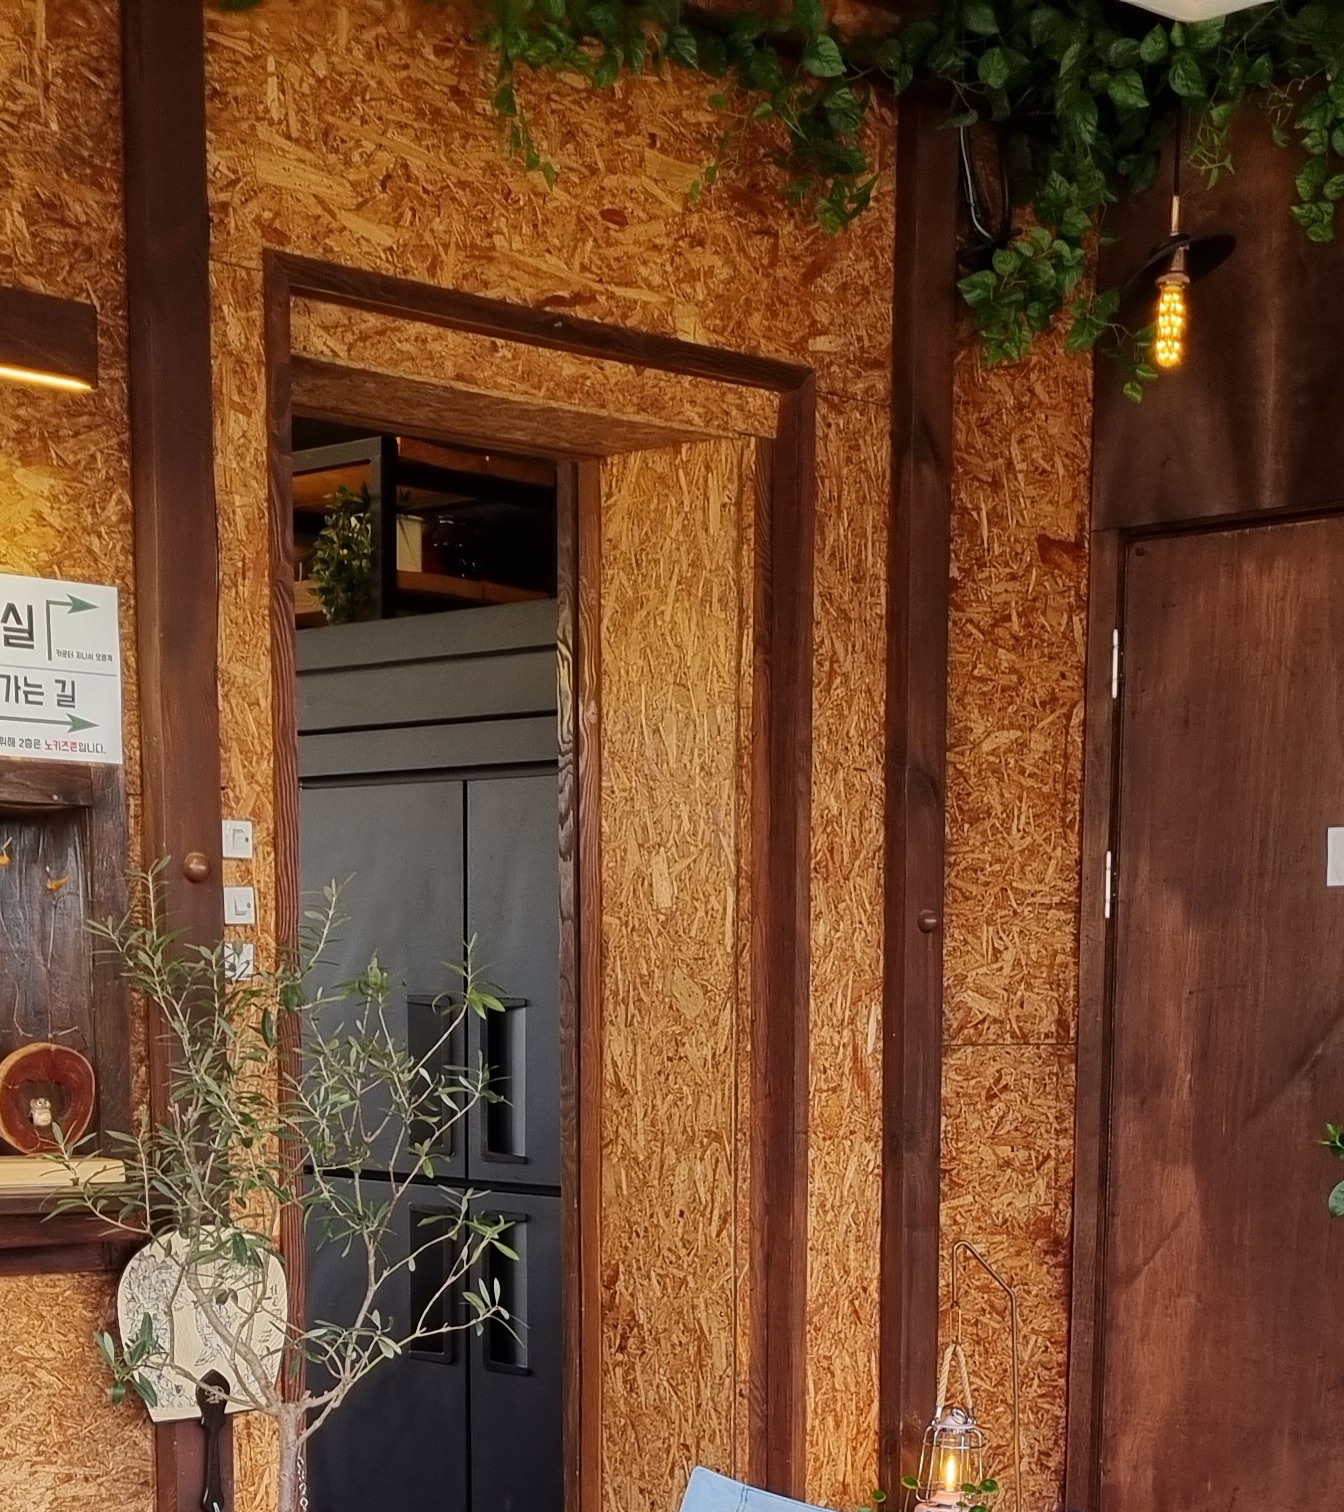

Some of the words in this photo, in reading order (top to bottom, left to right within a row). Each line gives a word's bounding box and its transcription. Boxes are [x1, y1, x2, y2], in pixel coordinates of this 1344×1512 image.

[55, 679, 76, 709] 길
[0, 736, 16, 747] 위해
[19, 738, 41, 749] 2층은
